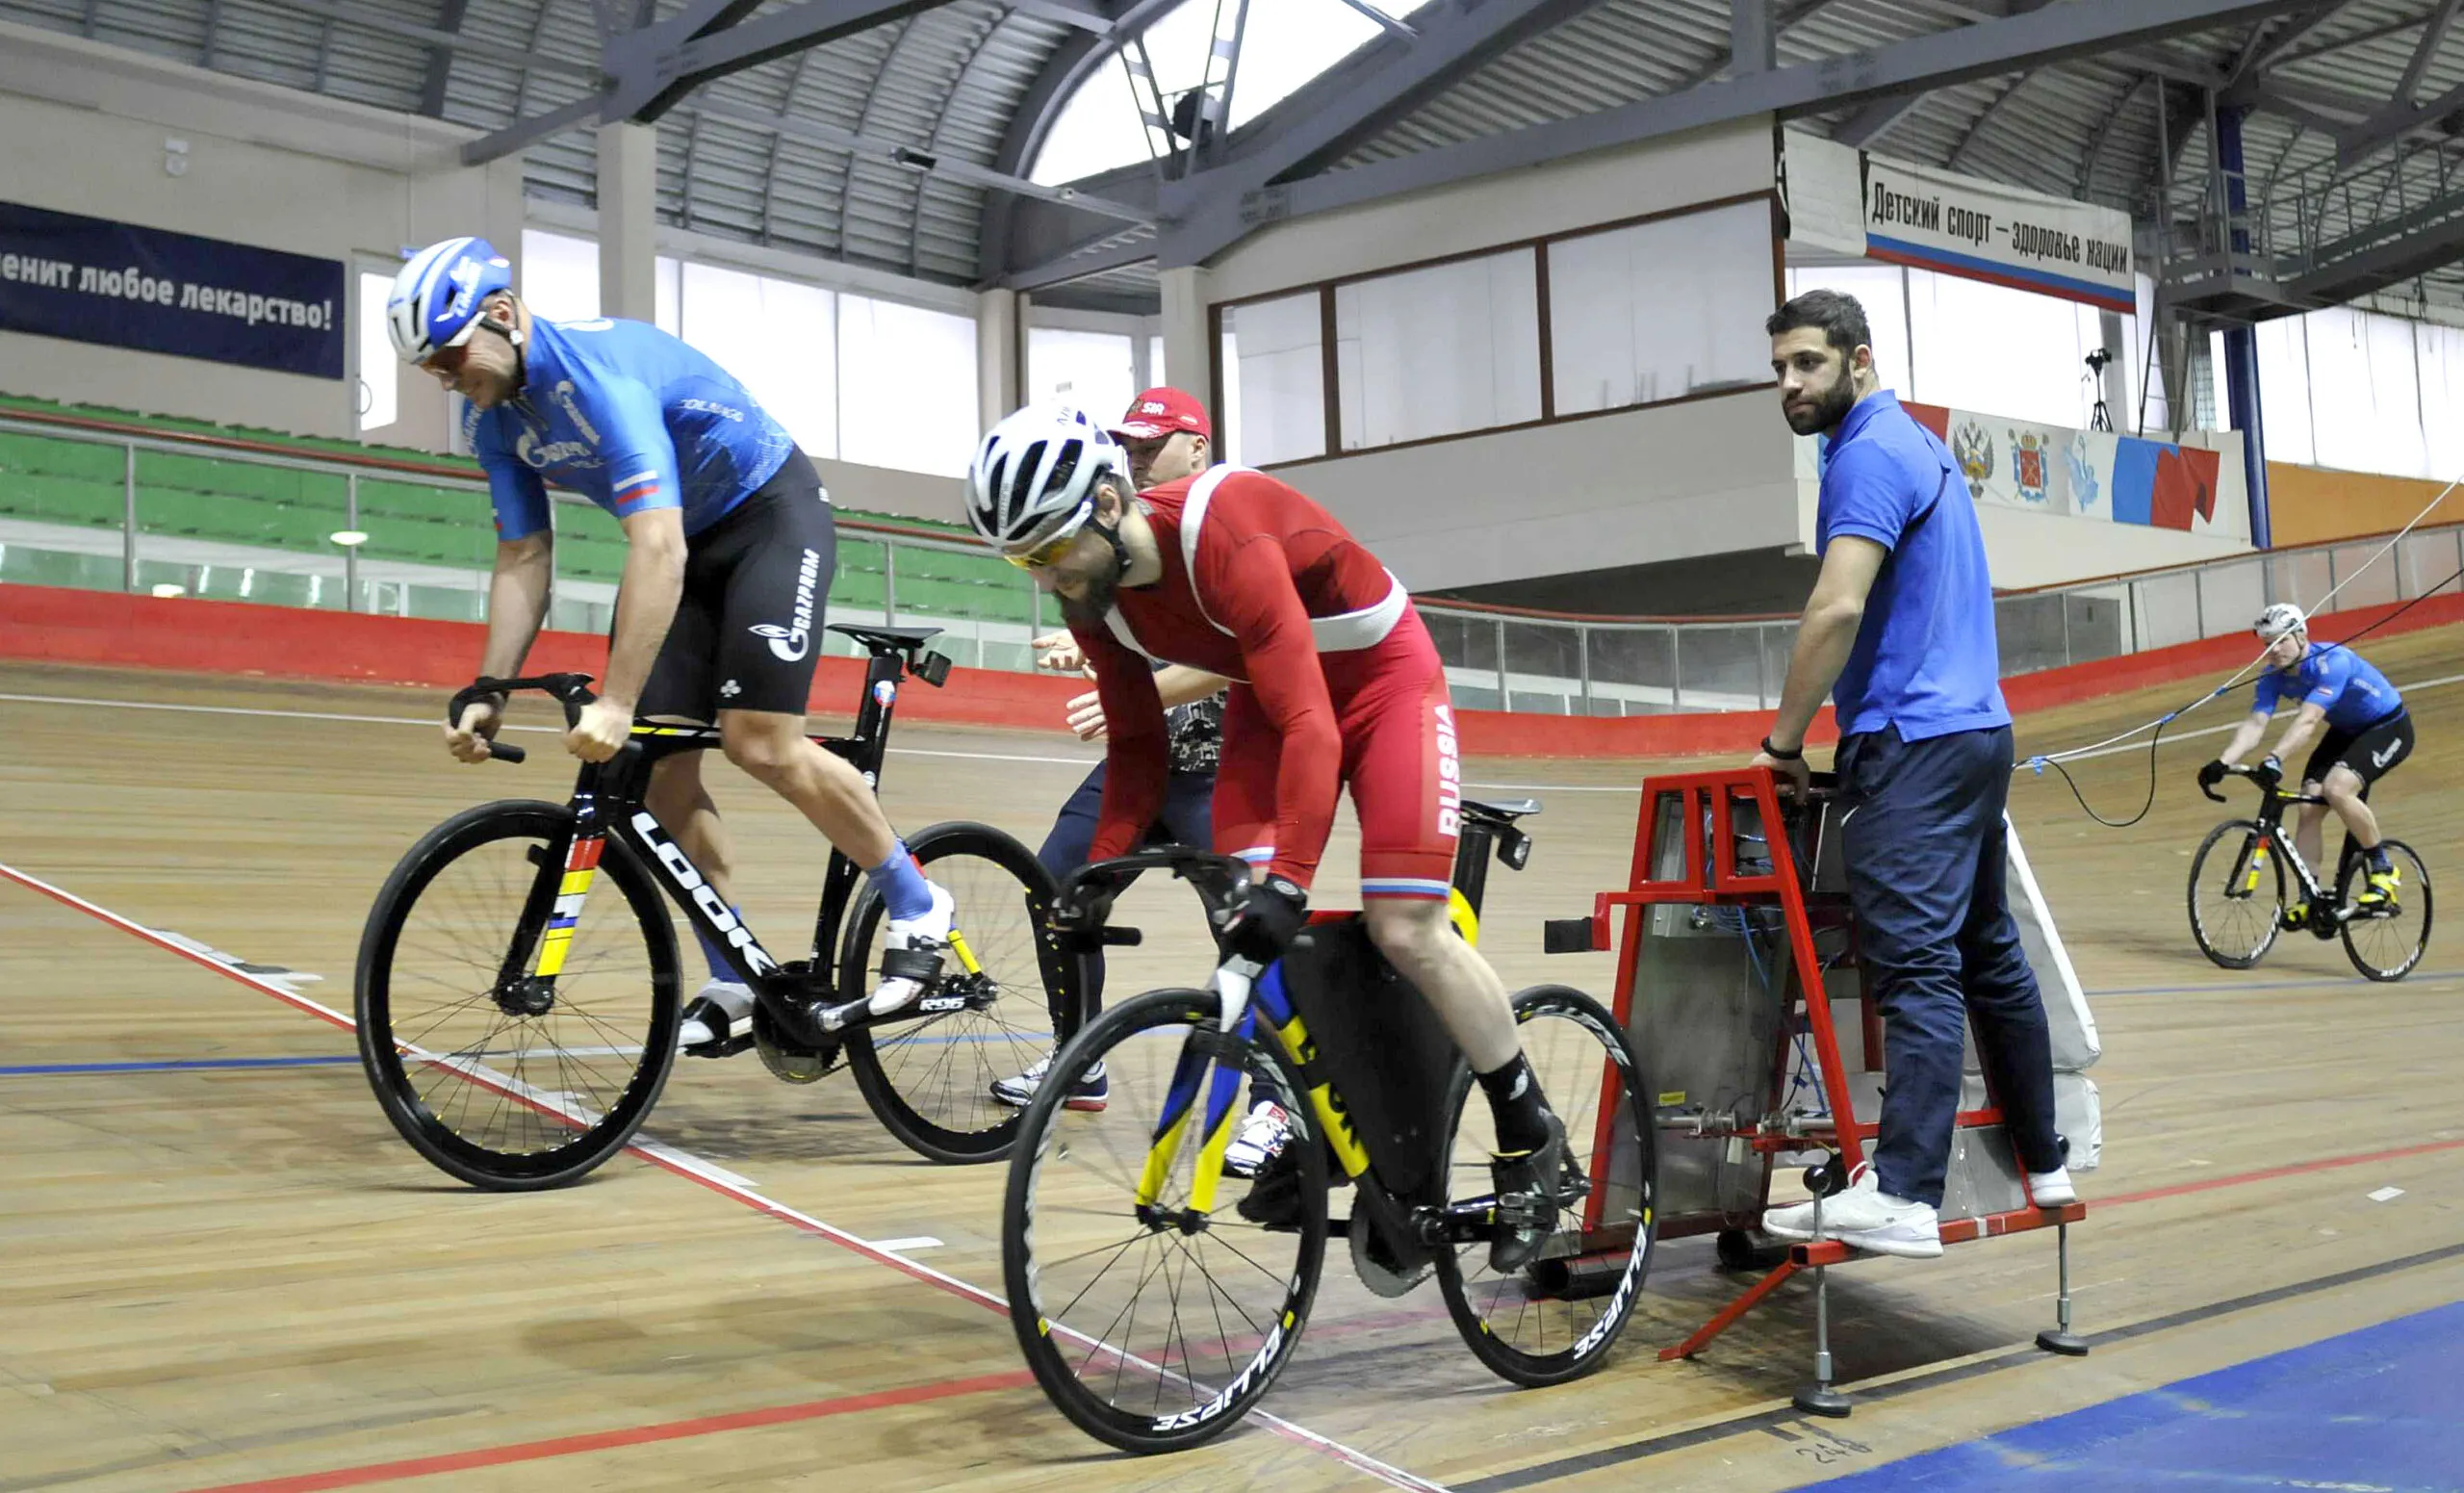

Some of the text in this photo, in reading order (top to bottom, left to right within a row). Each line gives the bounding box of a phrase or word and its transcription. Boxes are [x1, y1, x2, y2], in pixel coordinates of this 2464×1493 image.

[0, 252, 332, 331] енит любое лекарство!
[1872, 182, 1939, 232] Детский
[1947, 206, 1991, 246] спорт
[2013, 221, 2080, 263] здоровье
[2086, 239, 2127, 275] нации
[1433, 704, 1461, 837] RUSSIA
[631, 811, 778, 977] LOOK
[1573, 1223, 1647, 1360] ELLIPSE
